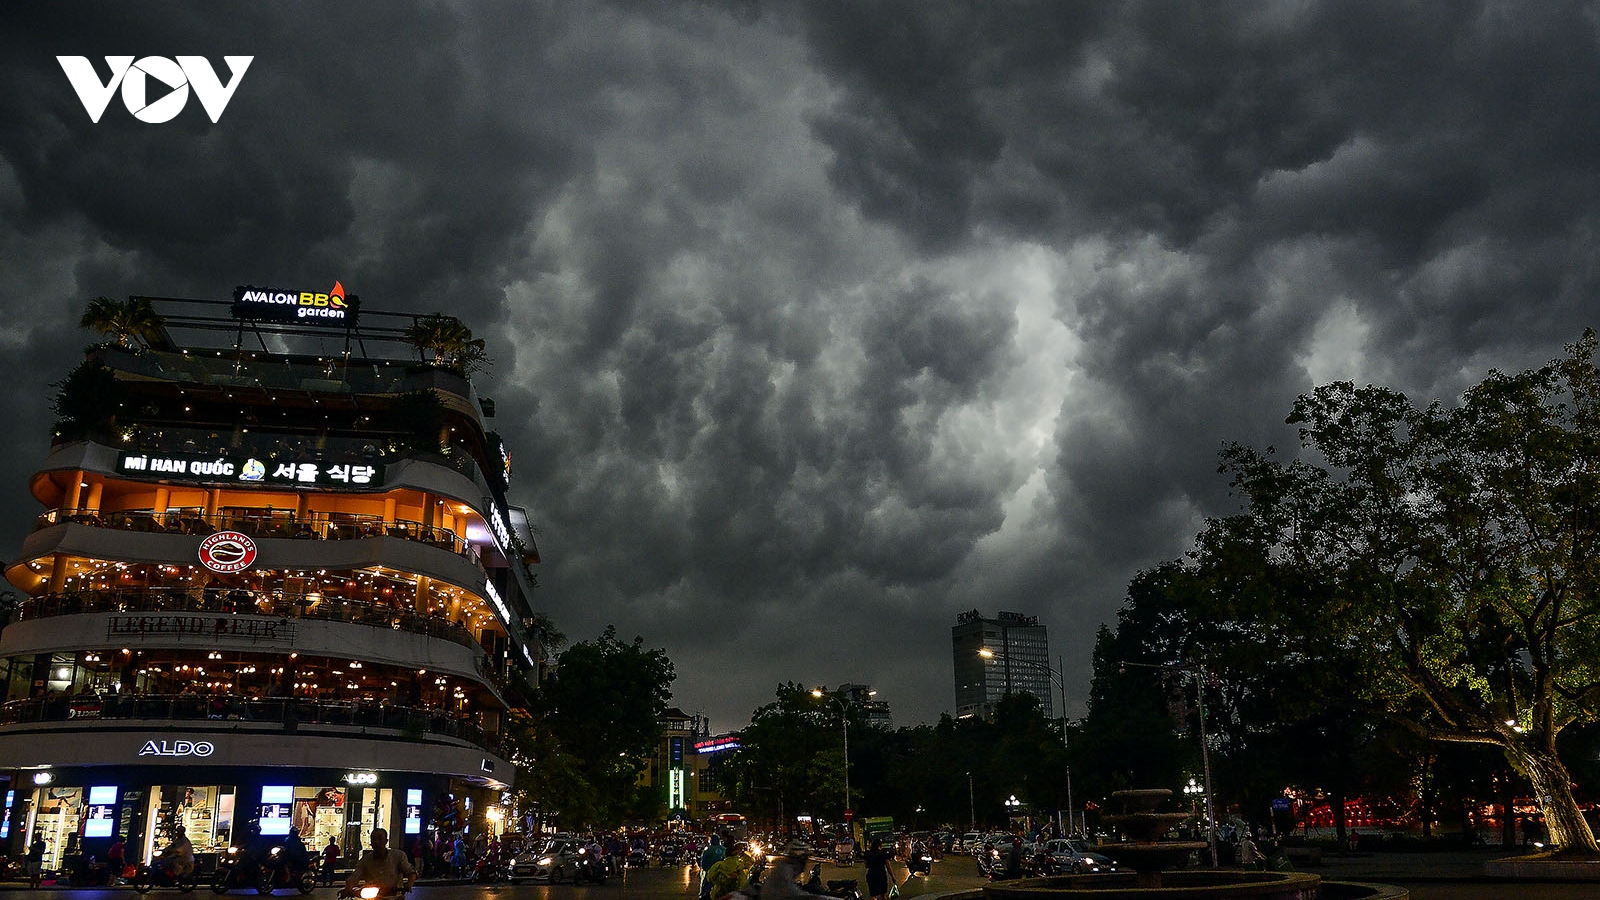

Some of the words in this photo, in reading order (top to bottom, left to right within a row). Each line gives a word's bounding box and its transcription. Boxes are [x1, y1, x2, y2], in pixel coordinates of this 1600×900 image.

[242, 291, 298, 305] AVALON
[297, 307, 345, 319] garden
[124, 454, 146, 470] MÌ
[190, 457, 234, 475] QUỐC
[272, 463, 318, 482] 서울
[325, 464, 375, 483] 식당
[202, 533, 254, 552] HIGHLANDS
[206, 560, 246, 571] COFFEE
[111, 616, 204, 633] LEGEND
[216, 618, 277, 638] BEER
[138, 740, 215, 757] ALDO
[339, 773, 377, 784] ALDO
